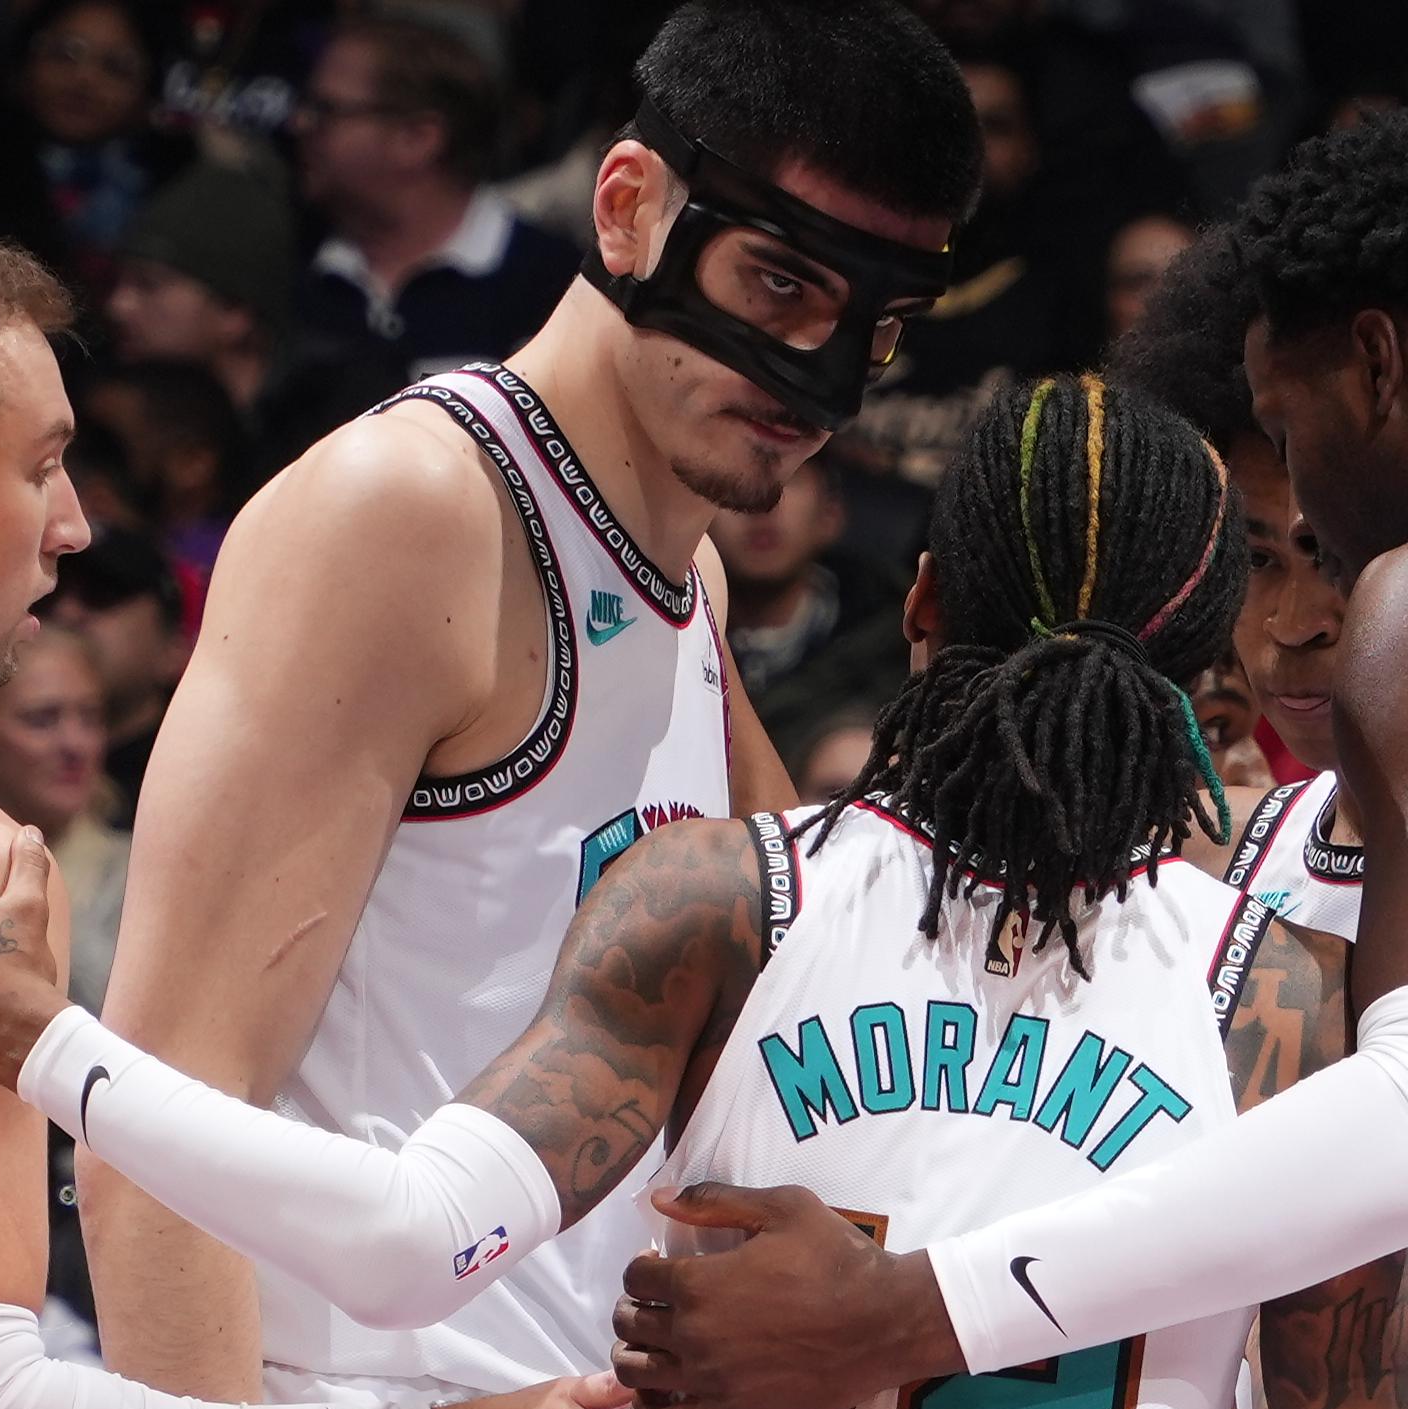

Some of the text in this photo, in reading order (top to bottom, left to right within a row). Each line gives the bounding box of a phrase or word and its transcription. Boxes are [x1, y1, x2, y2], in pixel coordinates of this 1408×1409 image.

[591, 589, 624, 625] NIKE
[987, 960, 1009, 974] NBA
[757, 1000, 1194, 1173] MORANT
